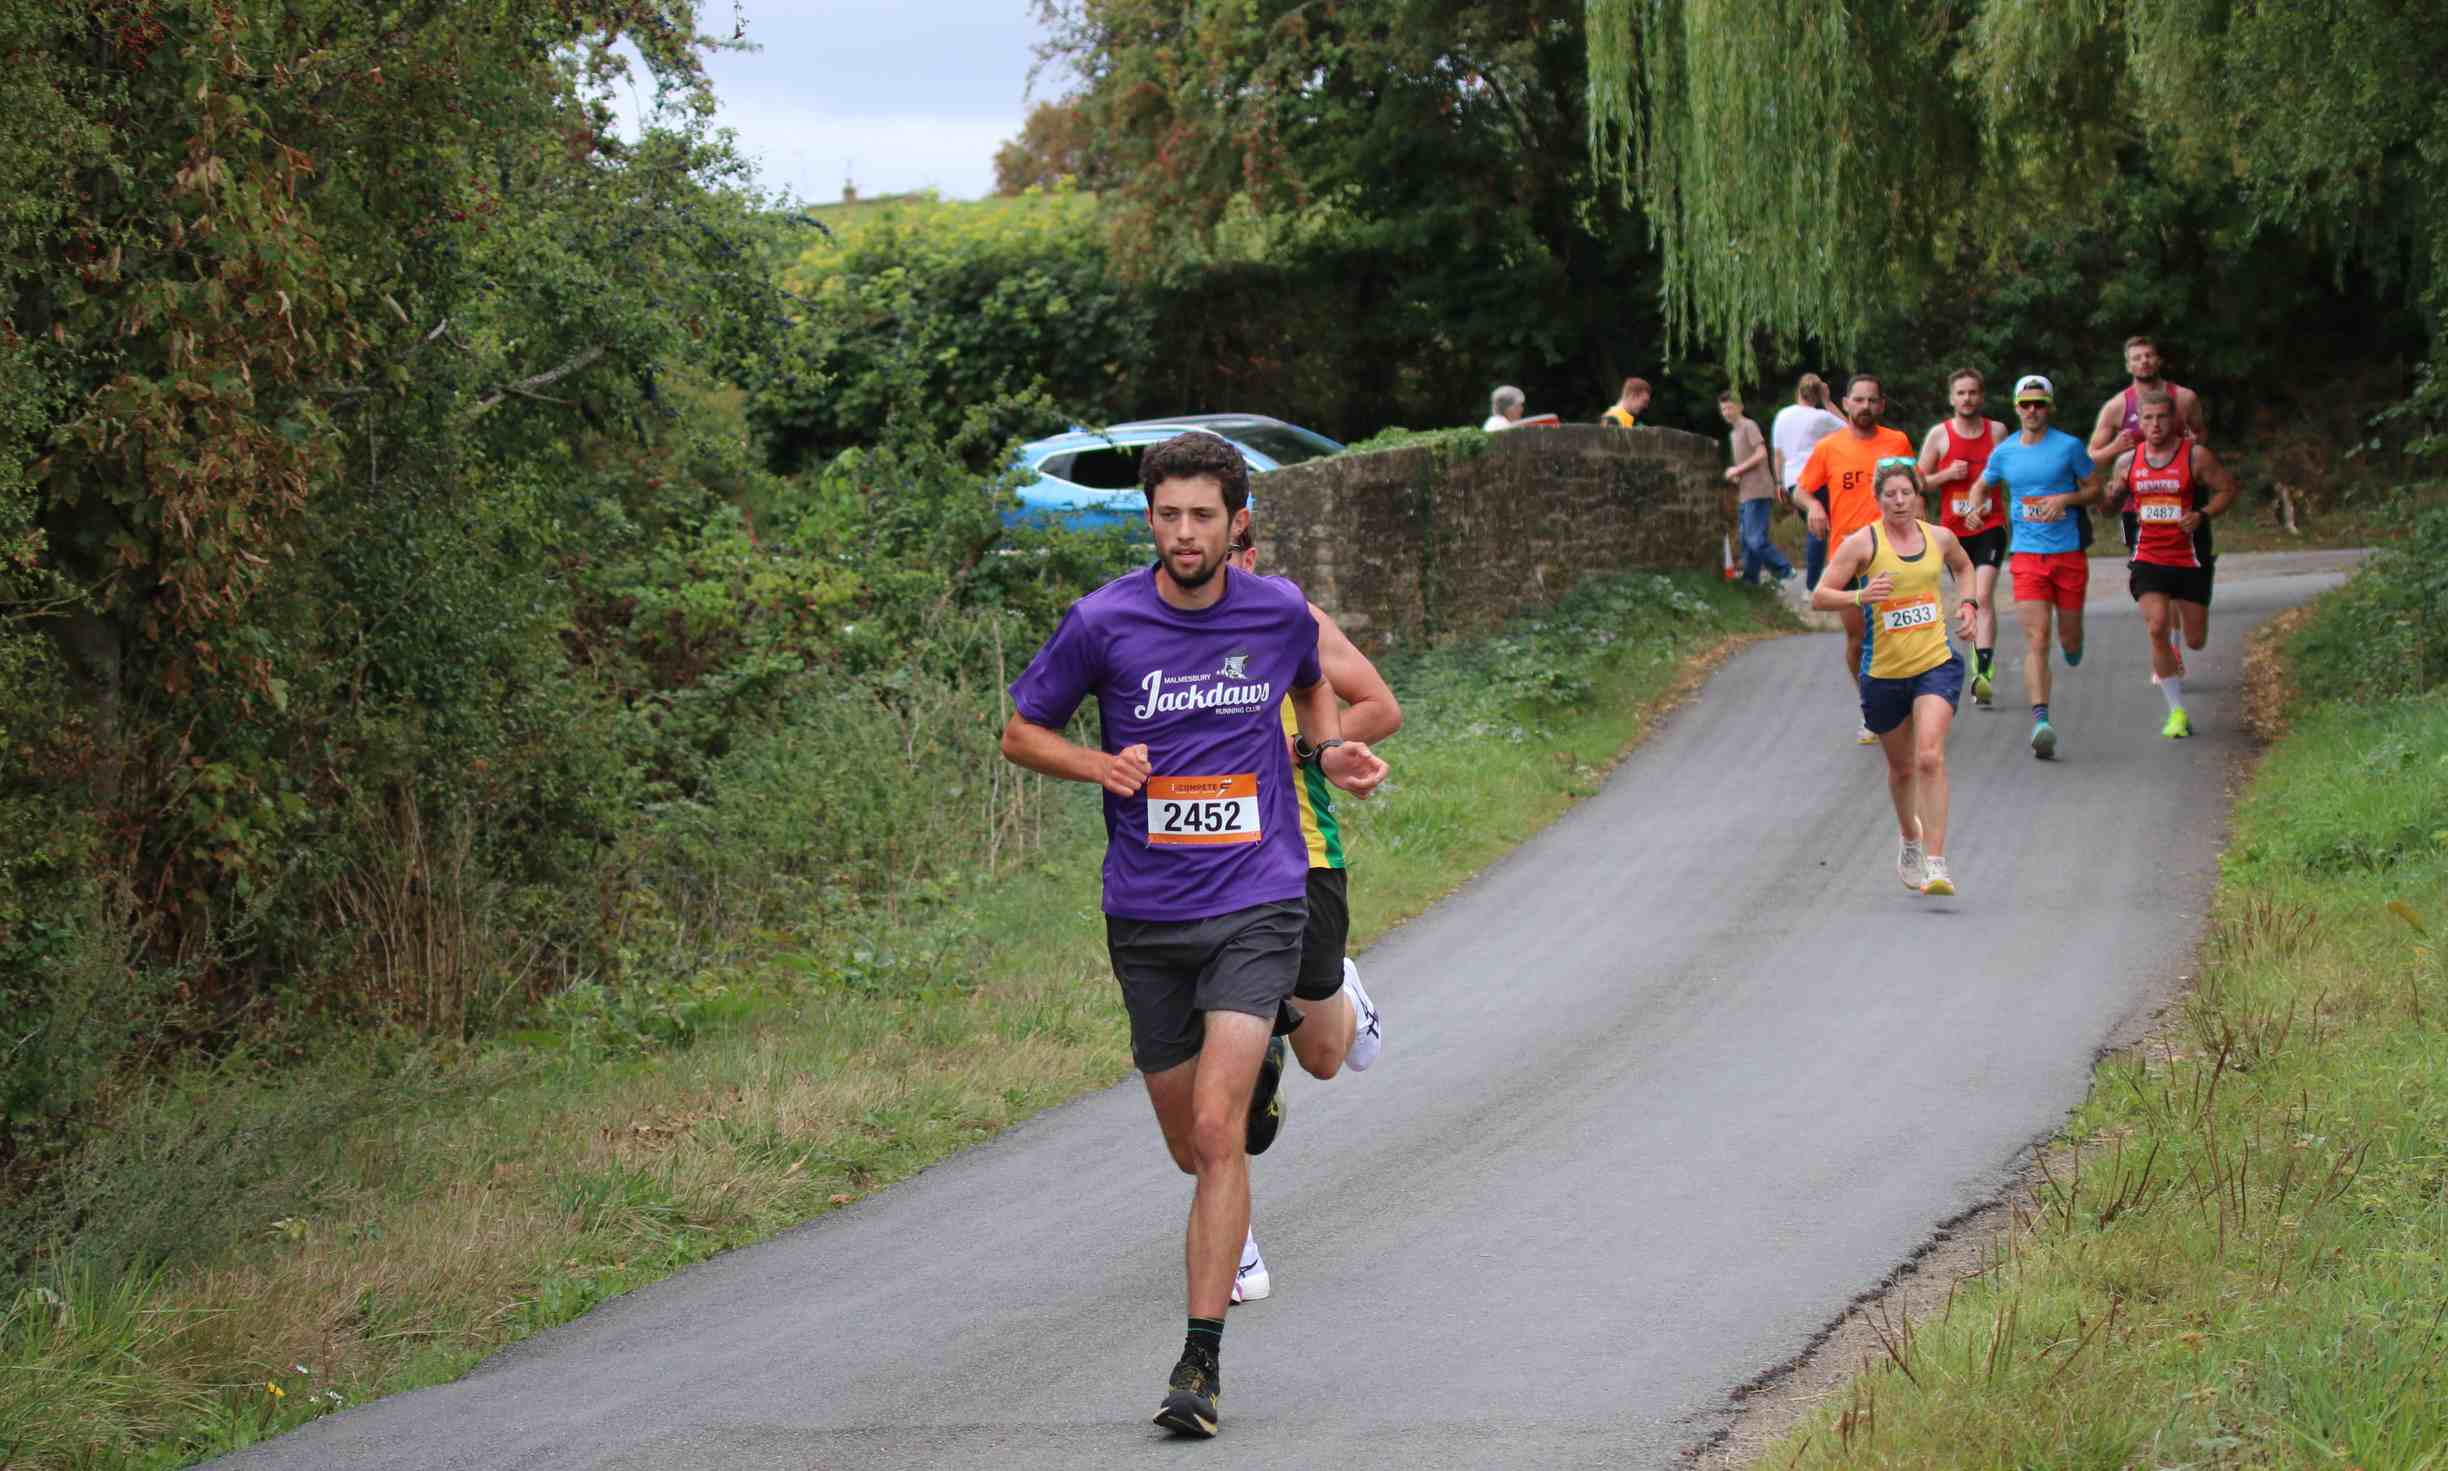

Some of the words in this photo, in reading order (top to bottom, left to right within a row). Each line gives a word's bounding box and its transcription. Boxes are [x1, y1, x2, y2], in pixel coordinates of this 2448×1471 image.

[1842, 470, 1871, 490] gr
[2146, 506, 2177, 518] 2487
[1892, 606, 1932, 627] 2633
[1164, 673, 1212, 685] MALMESBURY
[1134, 669, 1270, 720] Jackdaws
[1245, 705, 1261, 714] CLUB
[1164, 801, 1242, 832] 2452
